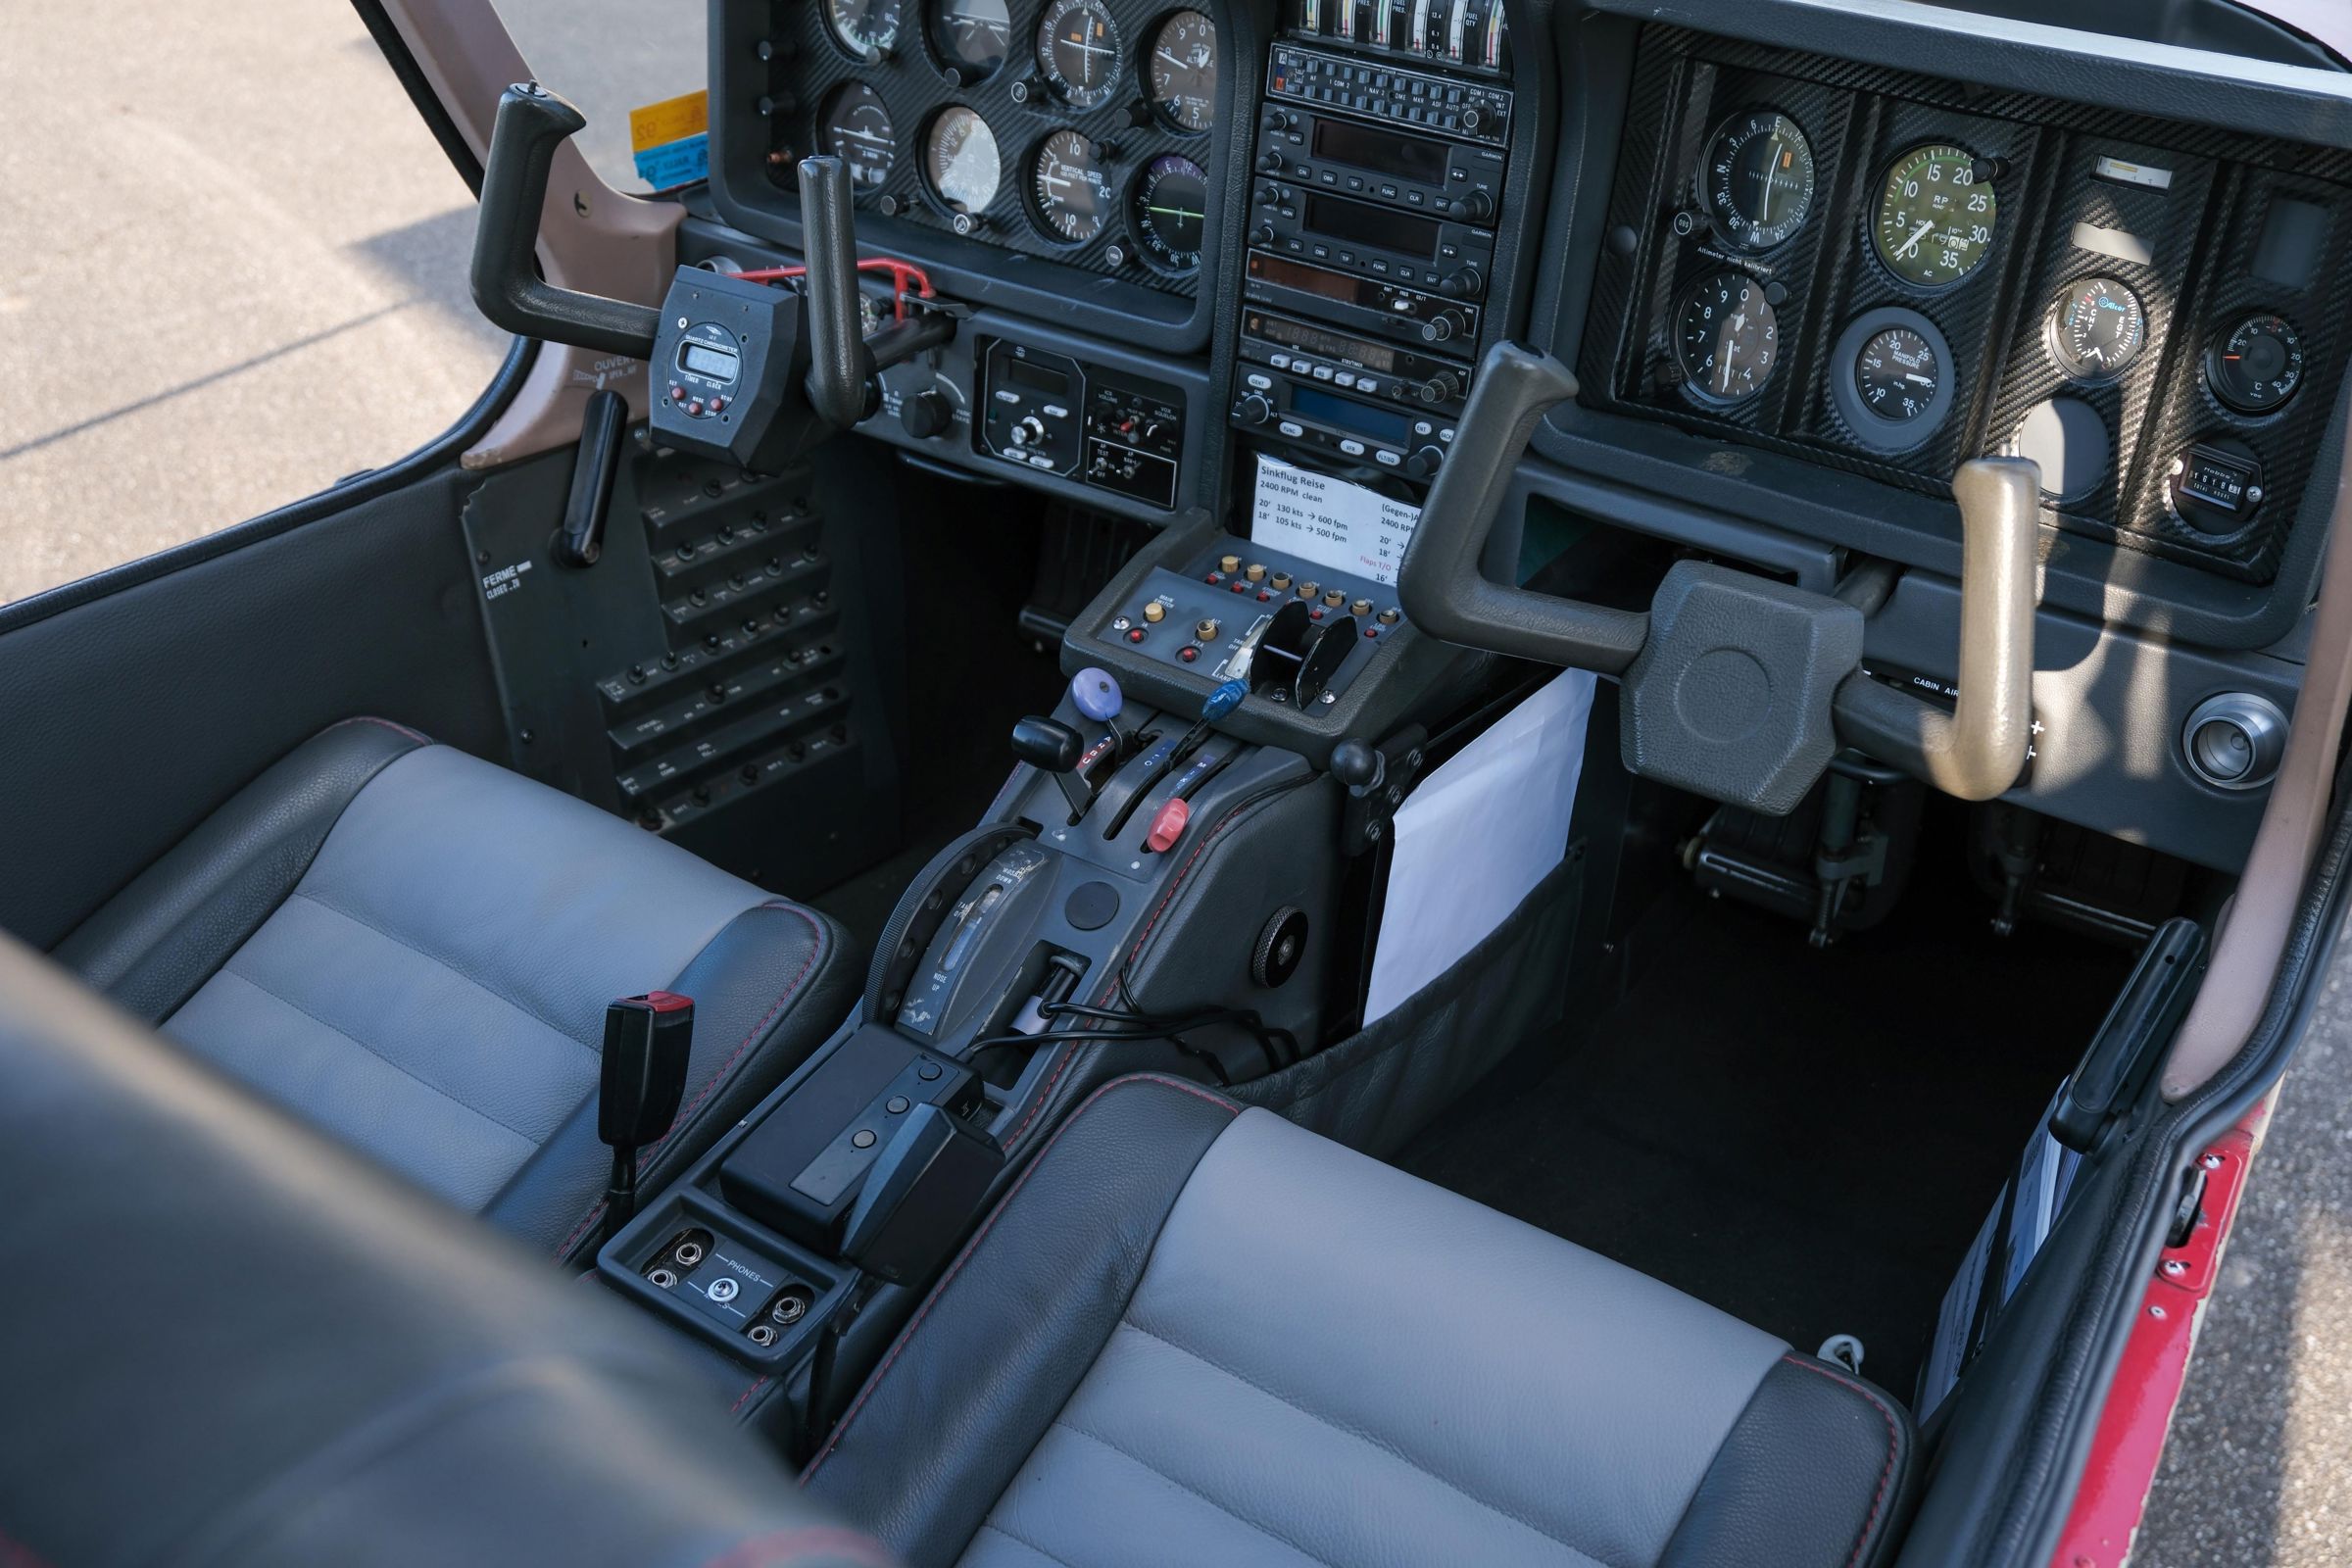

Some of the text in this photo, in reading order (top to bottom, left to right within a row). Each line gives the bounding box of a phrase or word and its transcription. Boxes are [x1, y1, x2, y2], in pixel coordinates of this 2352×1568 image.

[1465, 12, 1479, 21] FUEL
[1178, 27, 1186, 40] 9
[1199, 24, 1206, 36] 0
[1163, 73, 1170, 85] 7
[1173, 94, 1181, 106] 6
[1395, 92, 1406, 101] DME
[1192, 107, 1200, 119] 5
[1445, 103, 1459, 112] AUTO
[1750, 119, 1757, 128] 6
[1775, 116, 1782, 128] E
[1729, 136, 1737, 146] 3
[1069, 142, 1081, 156] 10
[1481, 151, 1502, 161] GARMIN
[1716, 164, 1727, 174] N
[1927, 163, 1942, 181] 15
[1952, 167, 1974, 186] 20
[1382, 187, 1395, 196] FUNC
[1904, 180, 1918, 198] 10
[1717, 191, 1727, 206] 33
[1967, 193, 1987, 213] 25
[1065, 213, 1077, 225] 10
[1895, 211, 1906, 228] 5
[1471, 228, 1493, 238] GARMIN
[1749, 231, 1761, 244] W
[1774, 229, 1786, 241] 24
[1968, 224, 1987, 244] 30
[1908, 242, 1919, 258] 0
[1696, 246, 1773, 274] Altimeter nicht kalibriert
[1939, 250, 1959, 269] 35
[1372, 263, 1387, 271] FUNC
[1721, 290, 1728, 303] 9
[1740, 288, 1749, 302] 0
[1703, 306, 1712, 319] 8
[1697, 329, 1706, 343] 7
[1765, 325, 1774, 340] 2
[2250, 327, 2258, 336] 10
[685, 334, 738, 353] QUARTZ CHRONOMETER
[1888, 339, 1901, 351] 20
[2286, 336, 2294, 345] 10
[1705, 354, 1713, 368] 6
[1760, 352, 1769, 365] 3
[1891, 355, 1920, 369] PRESSURE
[1892, 350, 1921, 365] MANIFOLD
[1917, 350, 1930, 362] 25
[1873, 358, 1882, 368] 15
[684, 374, 700, 384] TIMER
[1744, 368, 1752, 380] 4
[706, 381, 722, 390] CLOCK
[1250, 377, 1264, 386] IDENT
[2271, 379, 2281, 388] 40
[1877, 387, 1886, 397] 10
[1098, 393, 1118, 404] VOLUME
[1902, 397, 1915, 409] 35
[1154, 410, 1177, 420] SQUELCH
[1261, 466, 1326, 490] Sinkflug Reise
[1259, 481, 1323, 504] 2400 RPM clean
[1258, 498, 1348, 532] 20' 130 kts 600 fpm
[1257, 511, 1348, 544] 18' 105 kts 500 fpm
[1381, 516, 1399, 529] 2400
[1379, 535, 1392, 545] 20'
[1379, 548, 1391, 558] 18'
[1359, 556, 1392, 571] Flaps T/O
[482, 564, 517, 589] FERME
[1376, 572, 1388, 582] 16'
[1153, 599, 1175, 609] SWITCH
[1158, 594, 1174, 603] MAIN
[1913, 676, 1960, 698] CABIN AIR
[996, 874, 1013, 884] DOWN
[933, 972, 948, 984] NOSE
[931, 983, 941, 992] UP
[727, 1258, 761, 1283] PHONES
